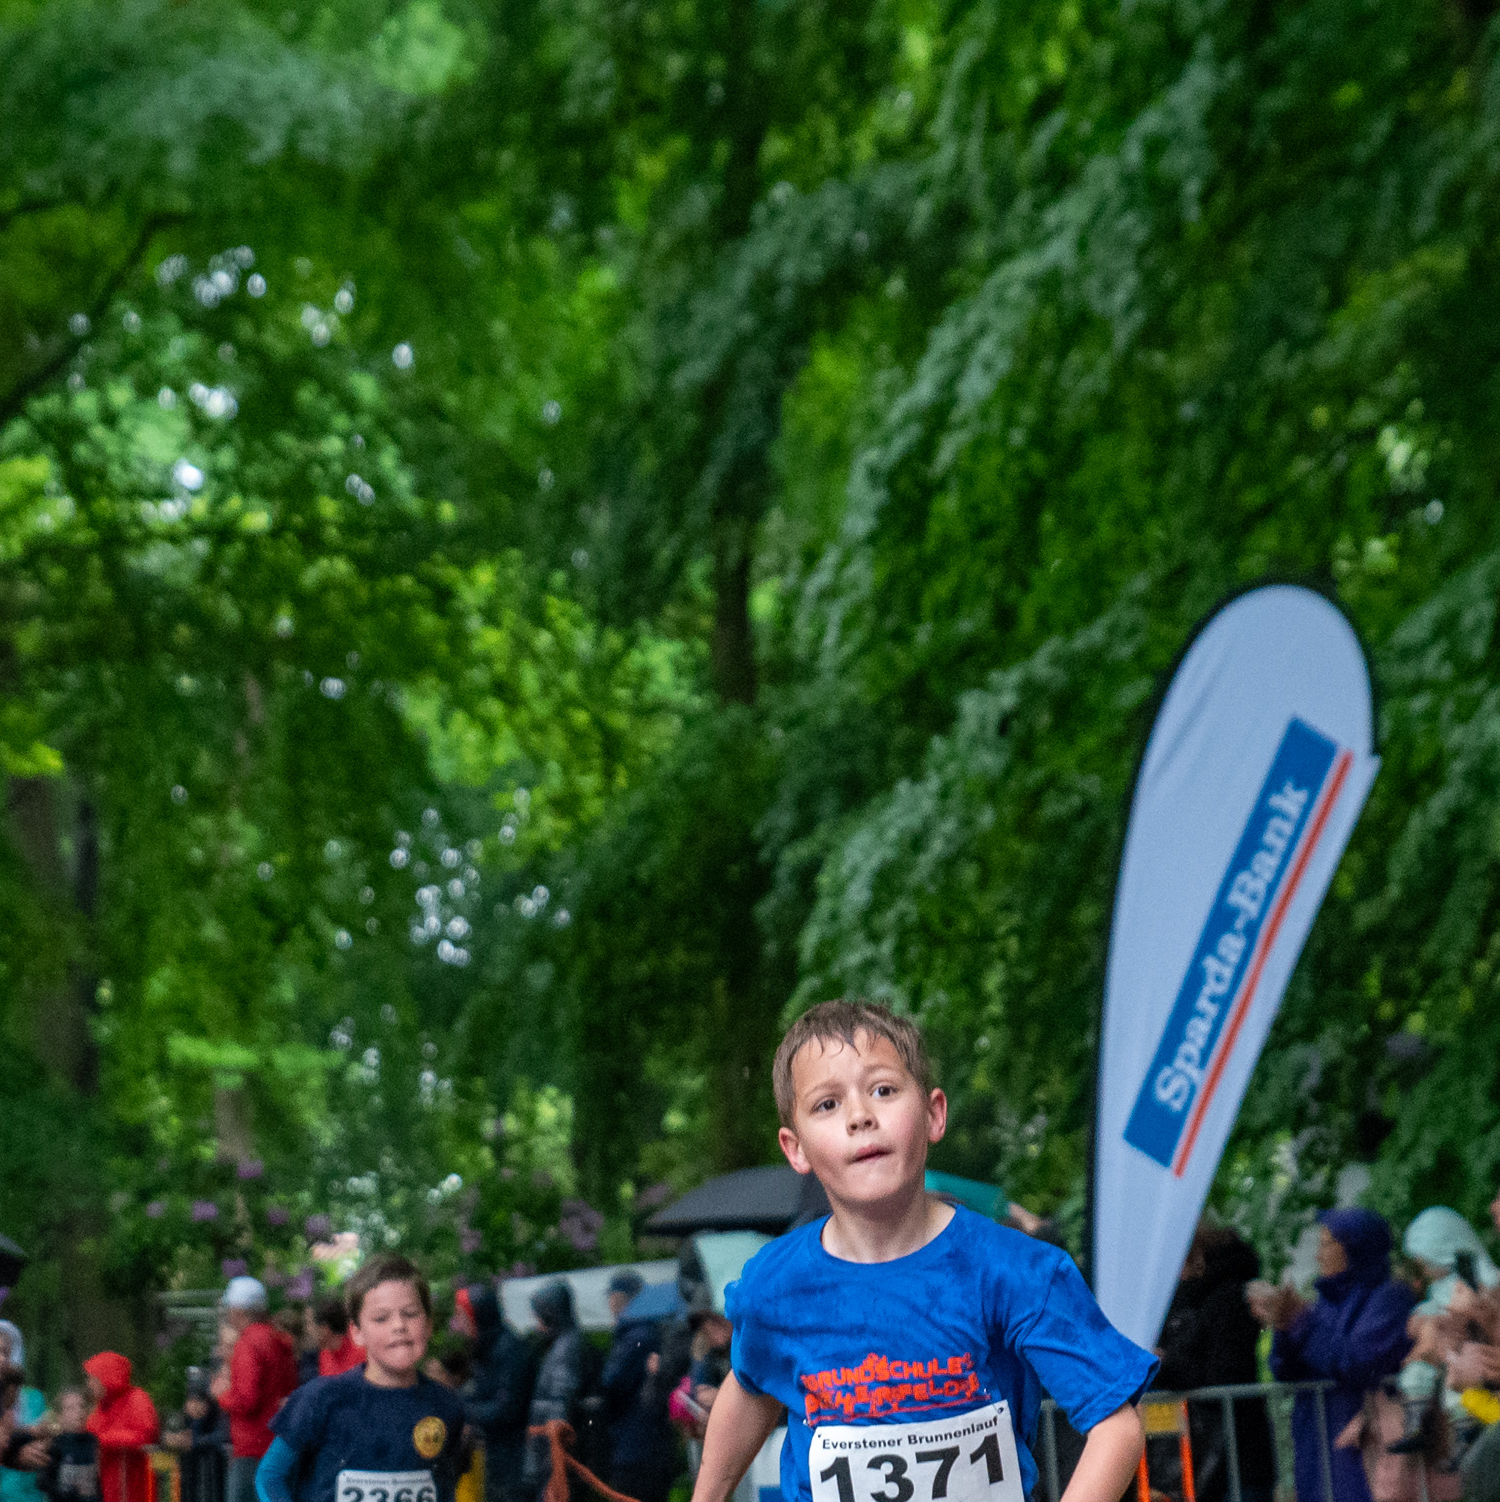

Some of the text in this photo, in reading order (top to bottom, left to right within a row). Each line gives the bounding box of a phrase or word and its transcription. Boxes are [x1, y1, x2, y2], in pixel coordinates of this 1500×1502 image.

[1154, 779, 1308, 1113] Sparda-Bank
[822, 1415, 999, 1450] Everstener Brunnenlauf
